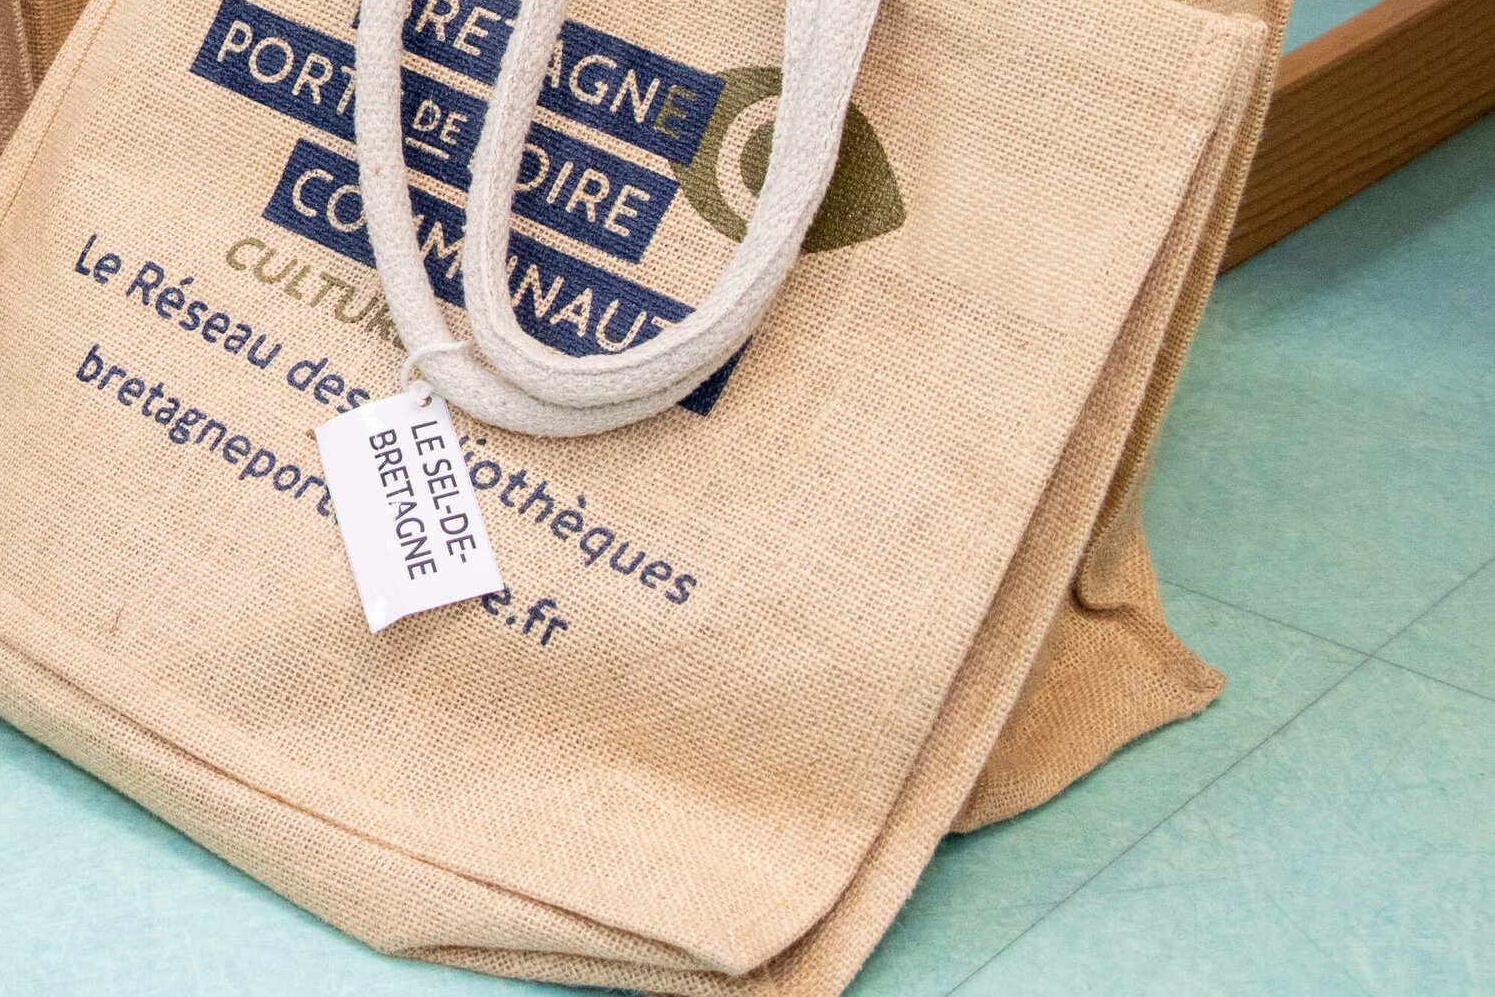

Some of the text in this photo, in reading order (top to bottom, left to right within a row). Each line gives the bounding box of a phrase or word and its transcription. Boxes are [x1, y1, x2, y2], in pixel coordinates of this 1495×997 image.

[215, 20, 652, 238] PORT DE OIRE
[73, 233, 123, 285] Le
[124, 260, 283, 371] Réseau
[285, 356, 372, 415] des
[368, 429, 438, 581] BRETAGNE
[410, 420, 478, 565] LE SEL-DE-
